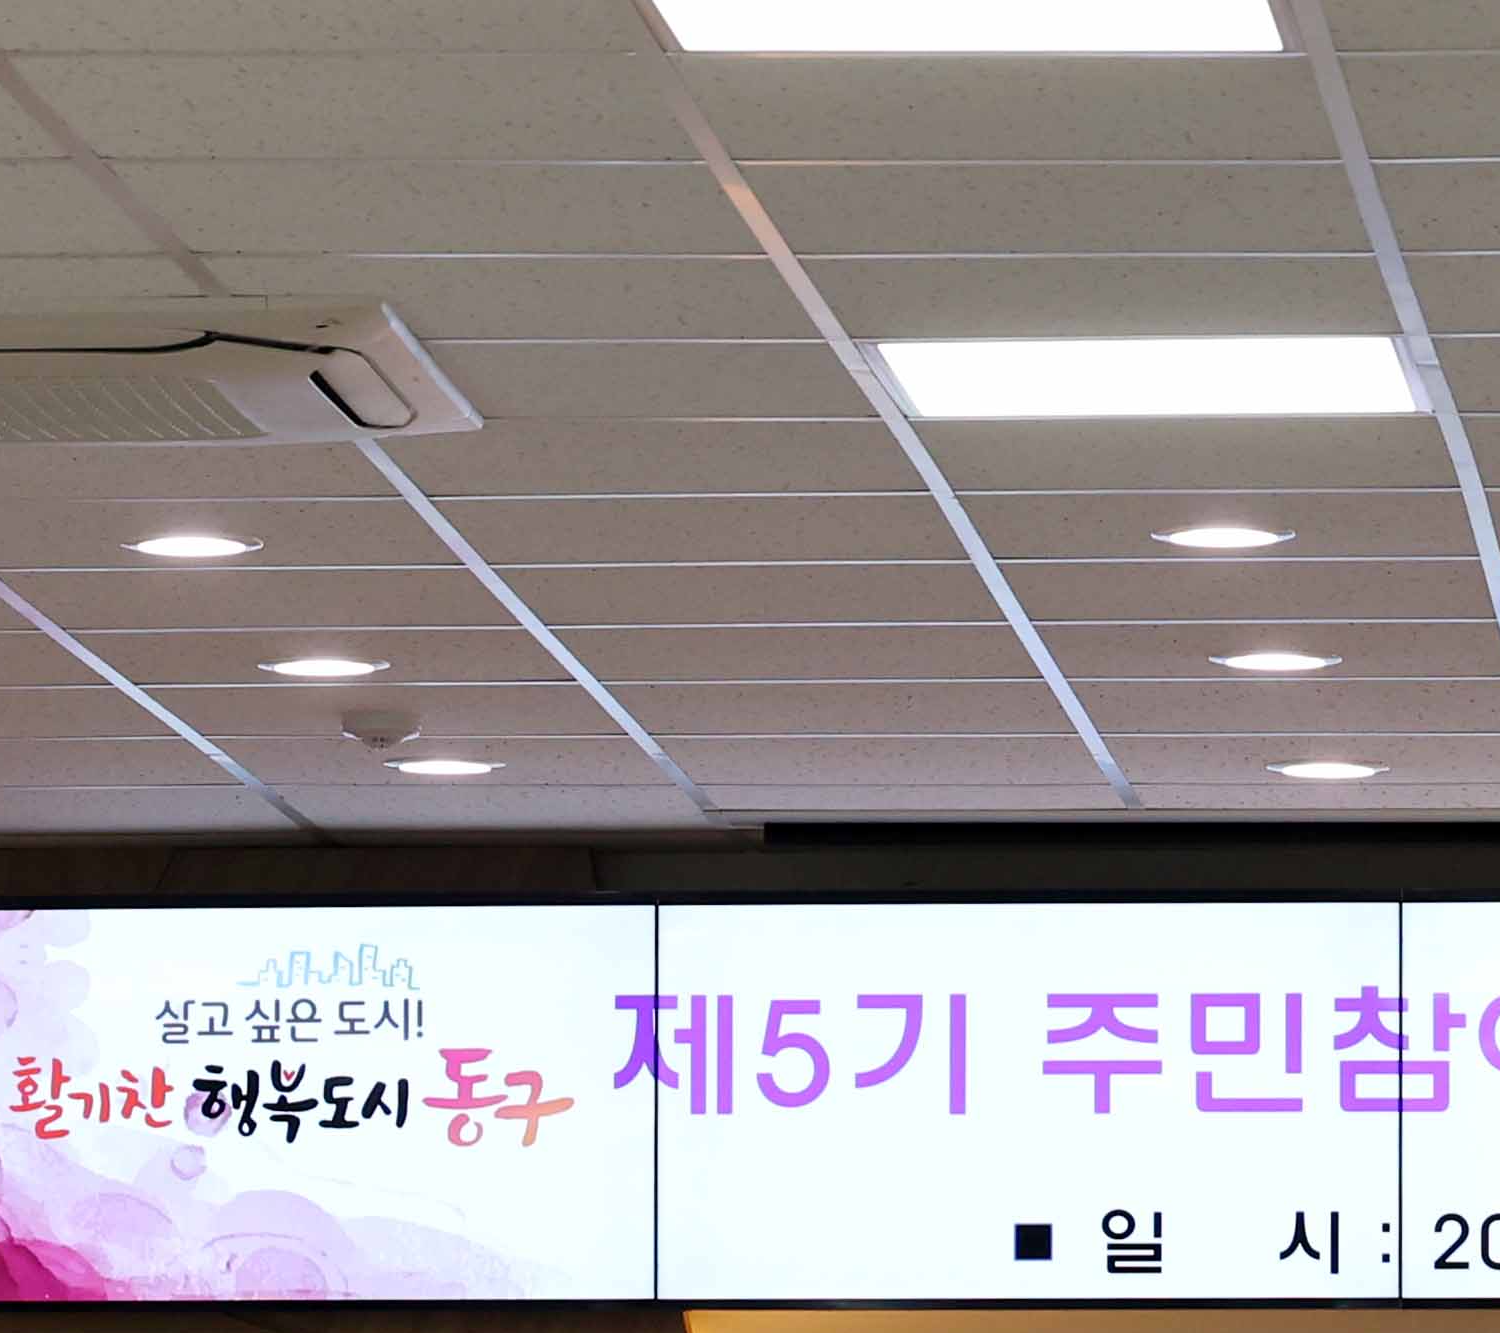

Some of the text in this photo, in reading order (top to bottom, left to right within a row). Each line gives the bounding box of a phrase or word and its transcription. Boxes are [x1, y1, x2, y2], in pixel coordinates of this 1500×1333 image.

[155, 998, 424, 1046] 살고 싶은 도시!
[613, 992, 968, 1115] 제5기
[8, 1047, 575, 1147] 활기찬 행복도시 동구
